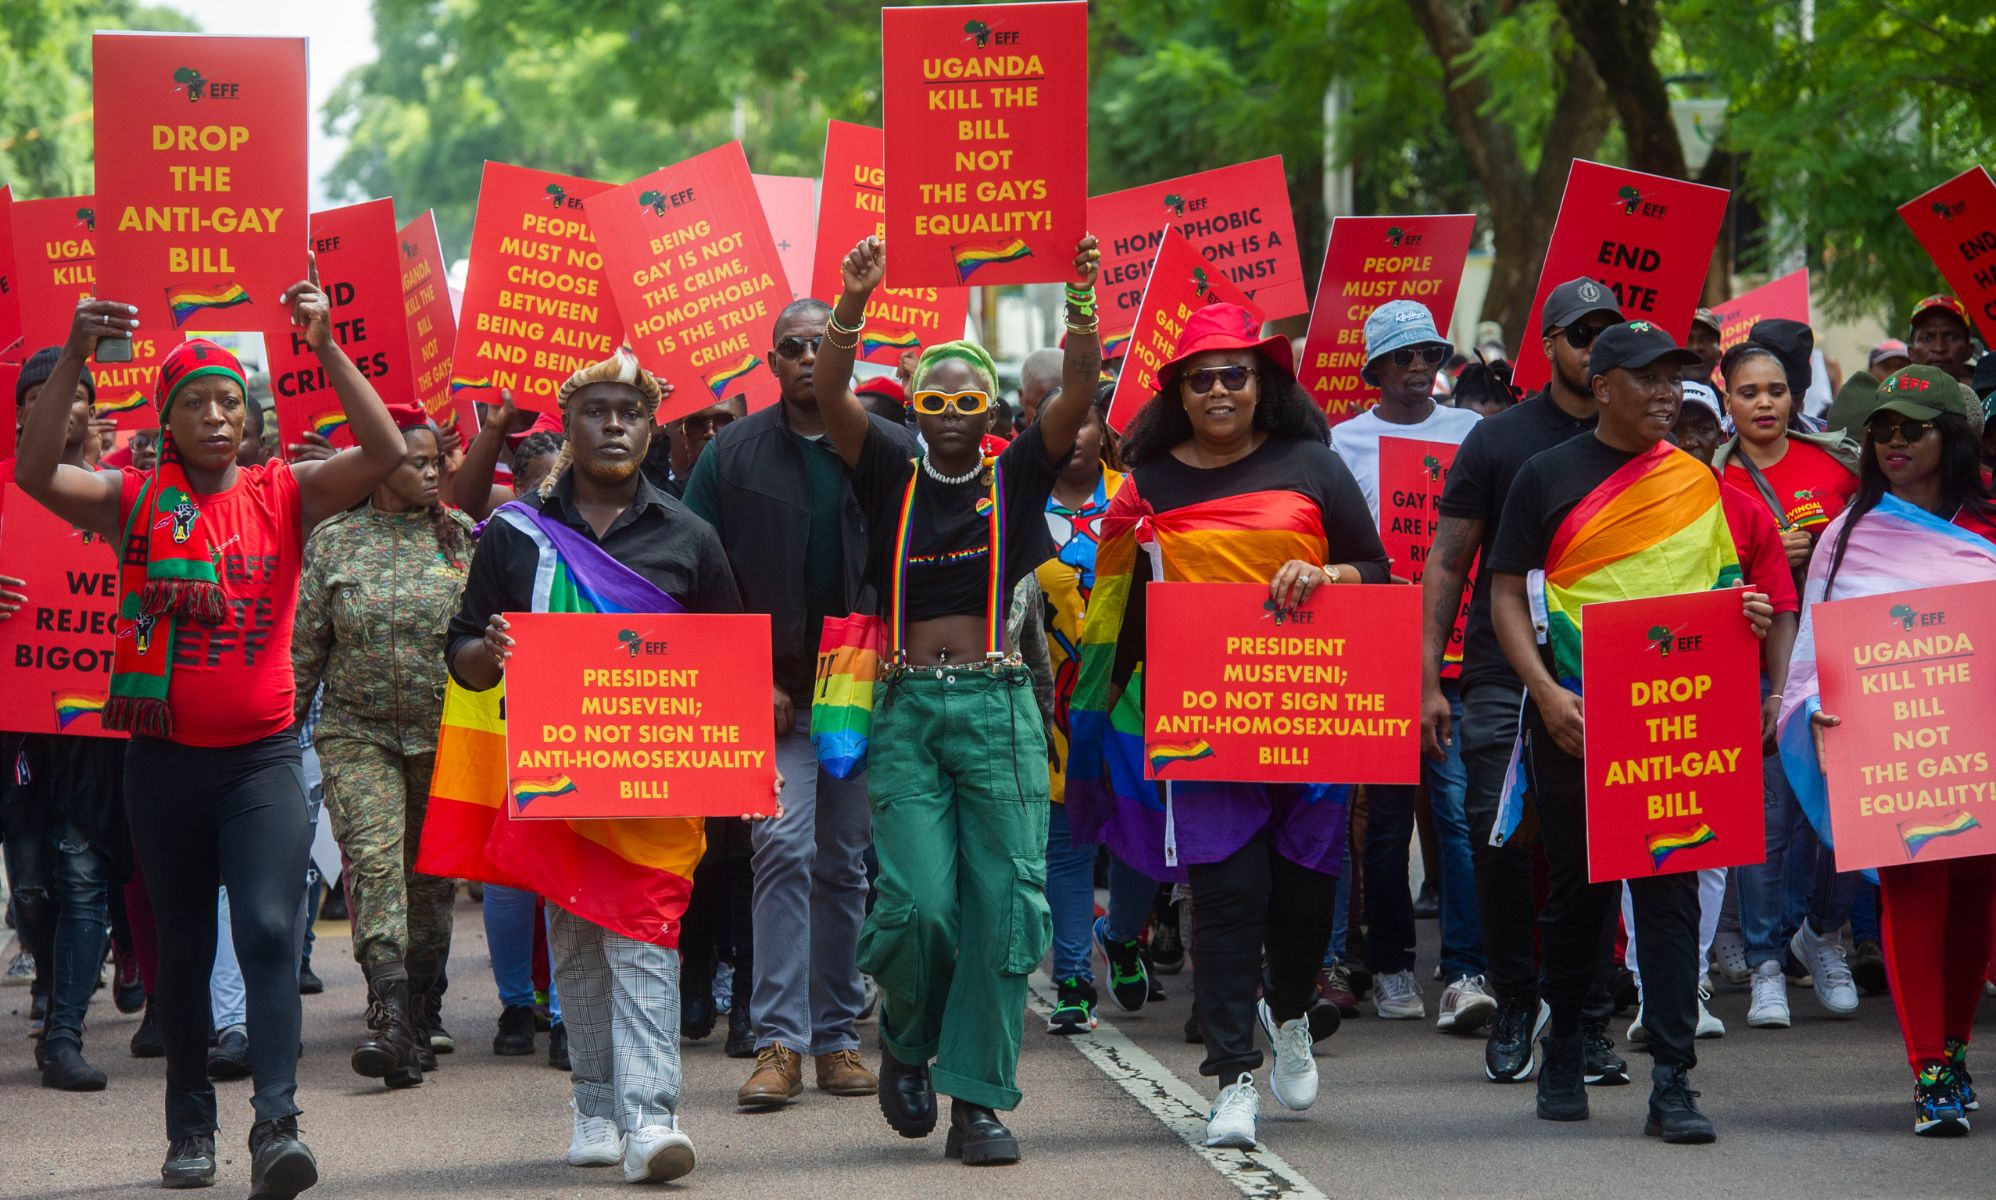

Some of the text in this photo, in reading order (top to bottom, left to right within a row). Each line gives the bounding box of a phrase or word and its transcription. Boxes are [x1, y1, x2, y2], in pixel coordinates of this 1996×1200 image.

[995, 31, 1020, 45] EFF
[923, 55, 1045, 79] UGANDA
[210, 83, 239, 97] EFF
[929, 86, 1038, 110] KILL THE
[152, 125, 249, 151] DROP
[958, 119, 1009, 141] BILL
[955, 149, 1013, 172] NOT
[169, 166, 231, 192] THE
[670, 188, 695, 207] EFF
[920, 179, 1047, 205] THE GAYS
[1188, 197, 1208, 212] EFF
[1642, 203, 1668, 218] EFF
[118, 207, 283, 232] ANTI-GAY
[915, 210, 1052, 236] EQUALITY!
[46, 239, 95, 259] UGA
[317, 236, 341, 252] EFF
[650, 220, 711, 255] BEING
[1241, 234, 1260, 253] IS
[1267, 231, 1282, 249] A
[1405, 235, 1422, 246] EFF
[169, 247, 235, 273] BILL
[500, 236, 603, 271] MUST NO
[632, 232, 744, 287] GAY IS NOT
[1363, 256, 1432, 273] PEOPLE
[1597, 241, 1661, 273] END
[403, 259, 431, 292] GANDA
[508, 265, 599, 297] CHOOSE
[642, 258, 749, 310] THE CRIME,
[420, 284, 435, 306] THE
[1342, 279, 1442, 298] MUST NOT
[1603, 280, 1658, 312] ATE
[498, 290, 599, 324] BETWEEN
[633, 272, 776, 339] HOMOPHOBIA
[417, 315, 433, 338] BILL
[476, 313, 612, 353] BEING ALIVE
[656, 300, 768, 355] IS THE TRUE
[1155, 309, 1184, 340] GAY
[291, 318, 367, 356] HTE
[1151, 329, 1175, 360] THE
[421, 338, 439, 363] NOT
[477, 341, 527, 365] AND
[690, 333, 750, 368] CRIME
[278, 352, 389, 397] CRIES
[418, 373, 433, 394] THE
[492, 369, 517, 390] IN
[1314, 376, 1359, 392] AND
[1899, 375, 1930, 392] EFF
[1326, 398, 1349, 415] IN
[1392, 491, 1427, 510] GAY
[1391, 519, 1422, 536] ARE
[226, 555, 277, 581] EFF
[906, 555, 935, 567] HEY
[67, 571, 116, 597] WE
[1291, 611, 1314, 624] EFF
[1920, 611, 1946, 627] EFF
[175, 631, 269, 666] EFF
[645, 642, 667, 653] EFF
[1226, 637, 1346, 657] PRESIDENT
[1678, 635, 1703, 650] EFF
[1854, 632, 1974, 665] UGANDA
[583, 669, 699, 688] PRESIDENT
[1223, 665, 1348, 686] MUSEVENI;
[1862, 663, 1971, 695] KILL THE
[1183, 691, 1385, 712] DO NOT SIGN THE
[1631, 674, 1713, 706] DROP
[581, 697, 702, 718] MUSEVENI;
[1893, 697, 1944, 720] BILL
[543, 724, 739, 743] DO NOT SIGN THE
[1155, 715, 1411, 737] ANTI-HOMOSEXUALITY
[1646, 714, 1697, 742] THE
[1893, 726, 1950, 751] NOT
[517, 749, 766, 769] ANTI-HOMOSEXUALITY
[1259, 746, 1309, 766] BILL!
[1605, 747, 1742, 787] ANTI-GAY
[1861, 752, 1988, 785] THE GAYS
[620, 780, 669, 799] BILL!
[1859, 782, 1996, 816] EQUALITY!
[1647, 791, 1703, 820] BILL
